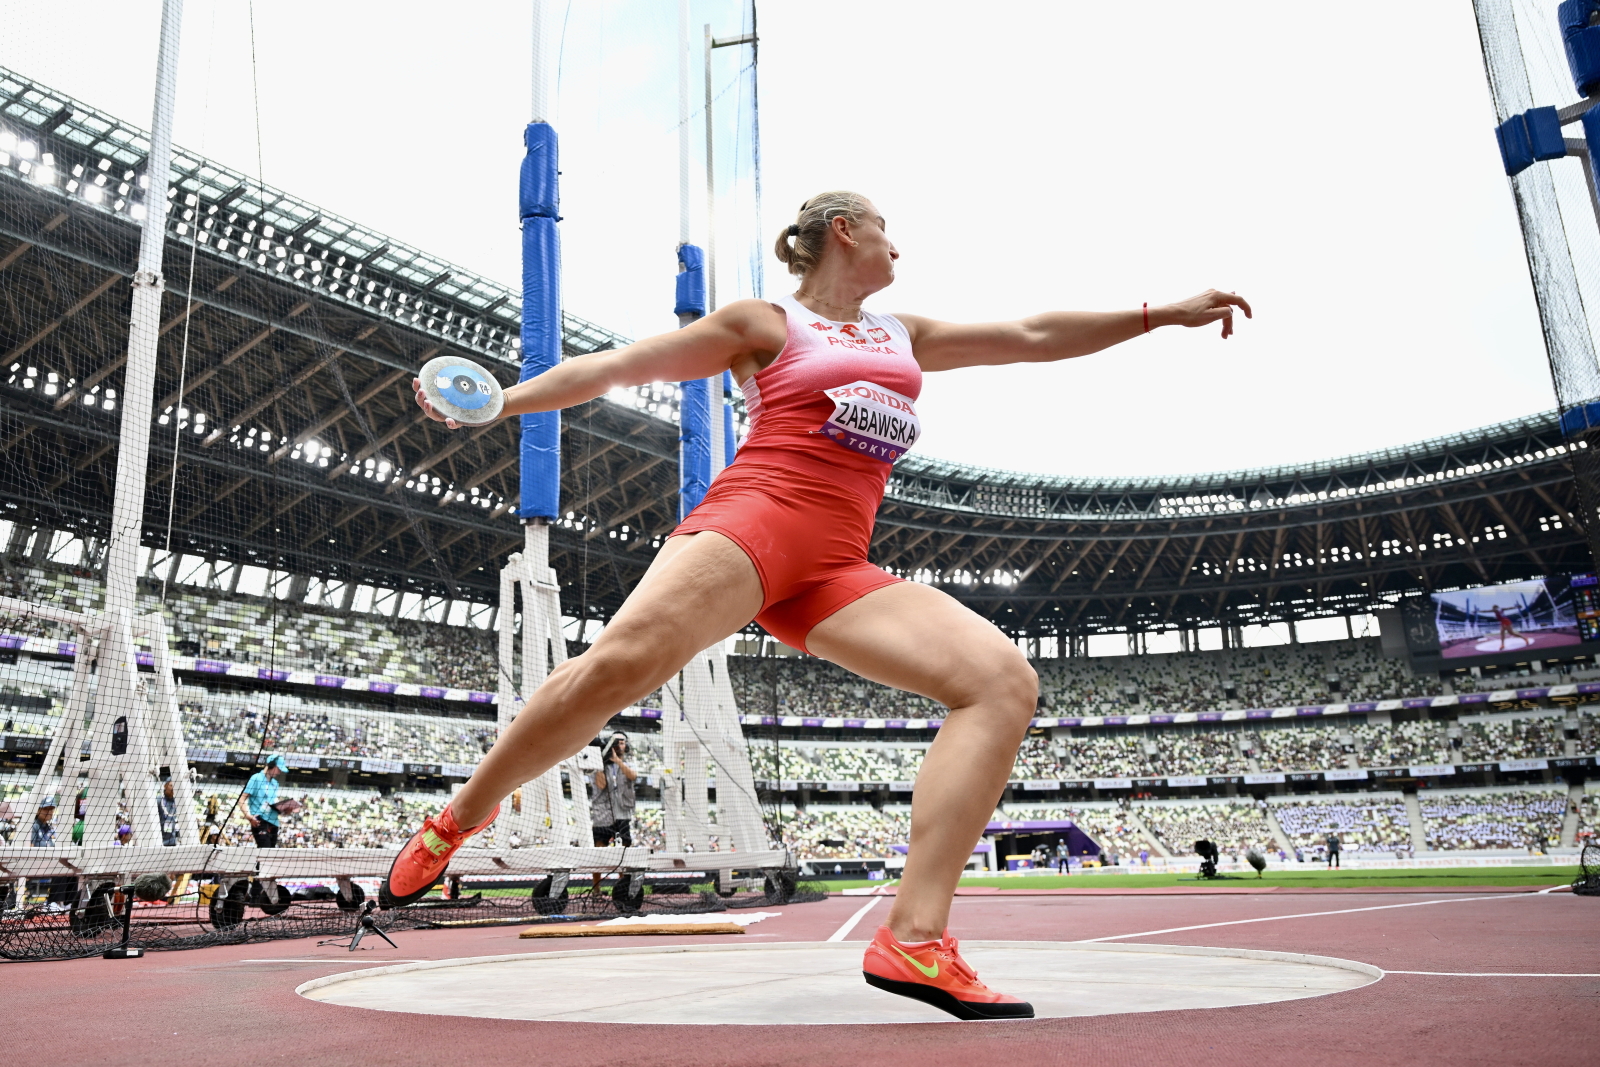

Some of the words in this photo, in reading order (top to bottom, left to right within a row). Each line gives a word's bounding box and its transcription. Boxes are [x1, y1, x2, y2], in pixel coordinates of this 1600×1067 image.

[827, 336, 899, 355] POLSKA
[829, 386, 917, 416] HONDA
[834, 401, 916, 446] ZABAWSKA
[421, 828, 453, 857] NIKE
